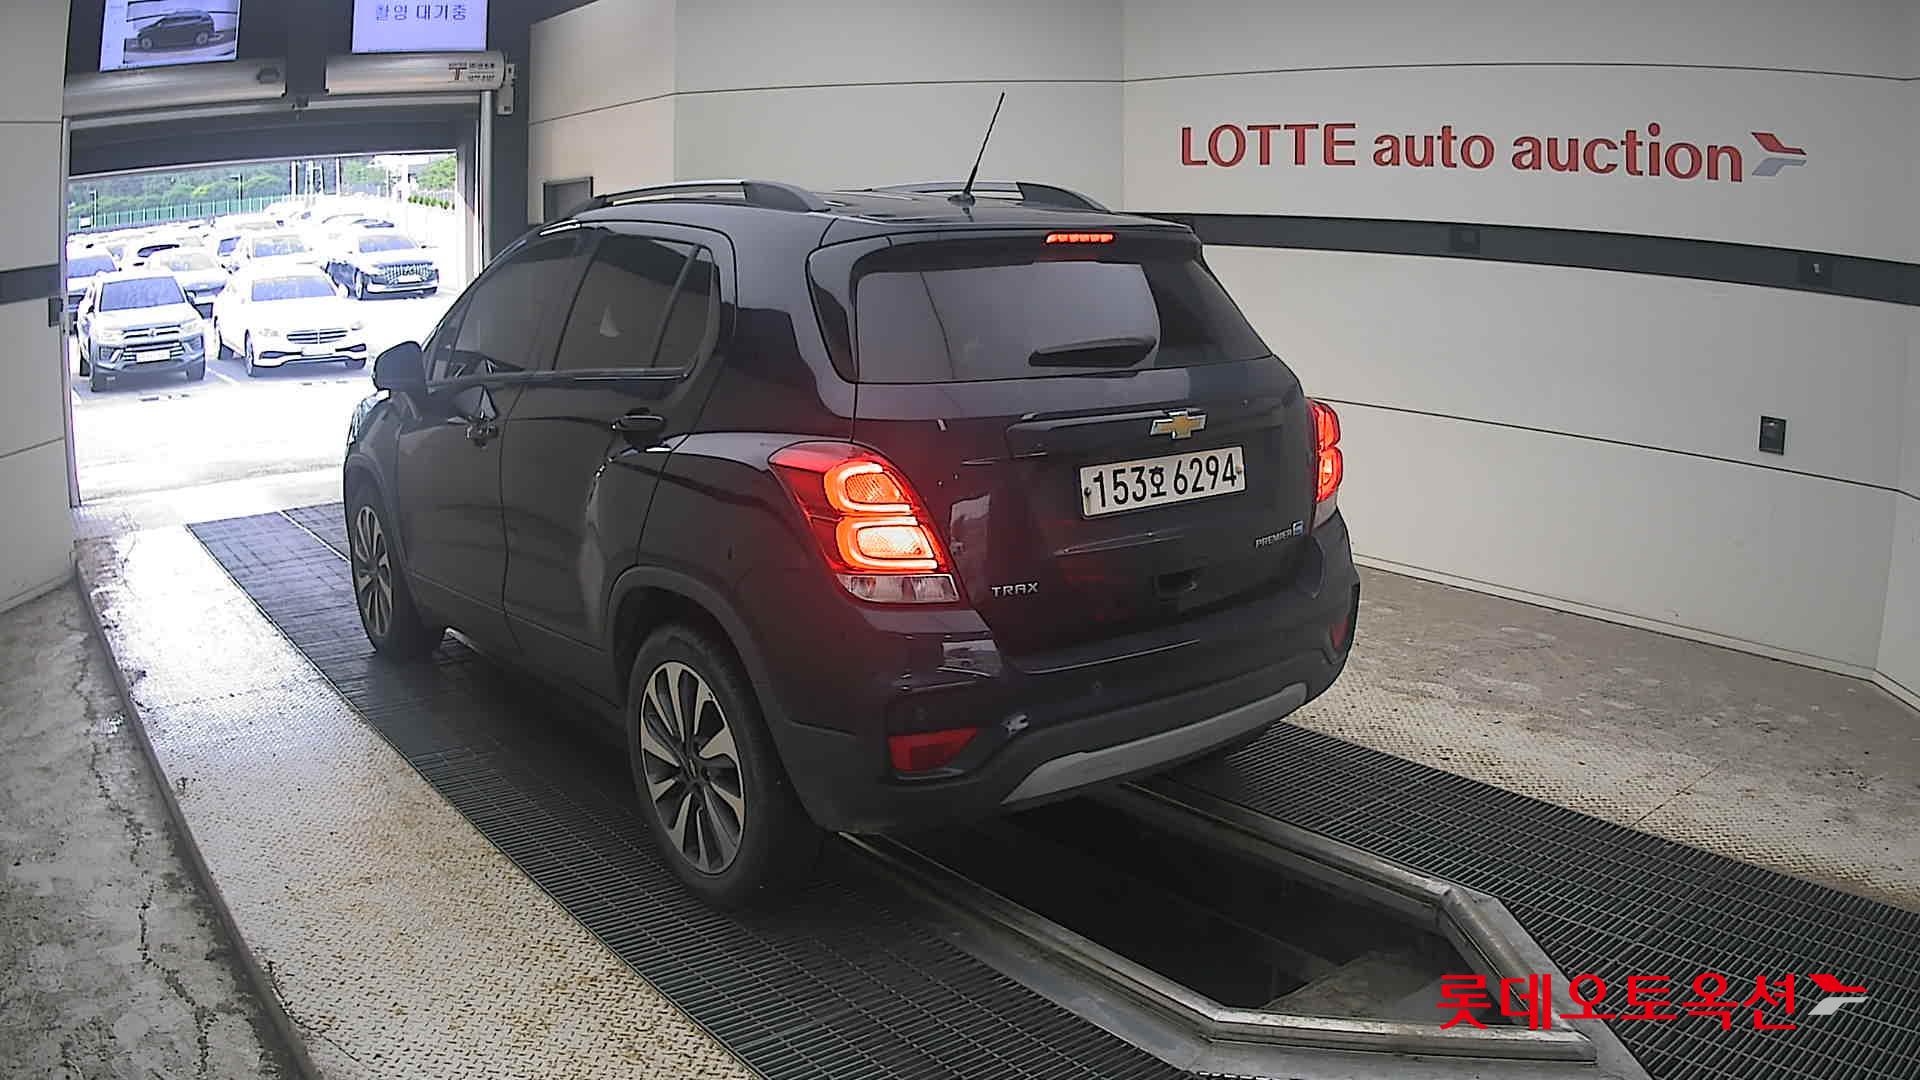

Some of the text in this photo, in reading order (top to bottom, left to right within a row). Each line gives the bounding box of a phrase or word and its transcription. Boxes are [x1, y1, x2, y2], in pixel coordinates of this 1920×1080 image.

[416, 4, 466, 21] 대기중
[1181, 122, 1743, 182] LOTTE auto auction
[1093, 453, 1238, 507] 153호 6294
[991, 582, 1038, 597] TRAX
